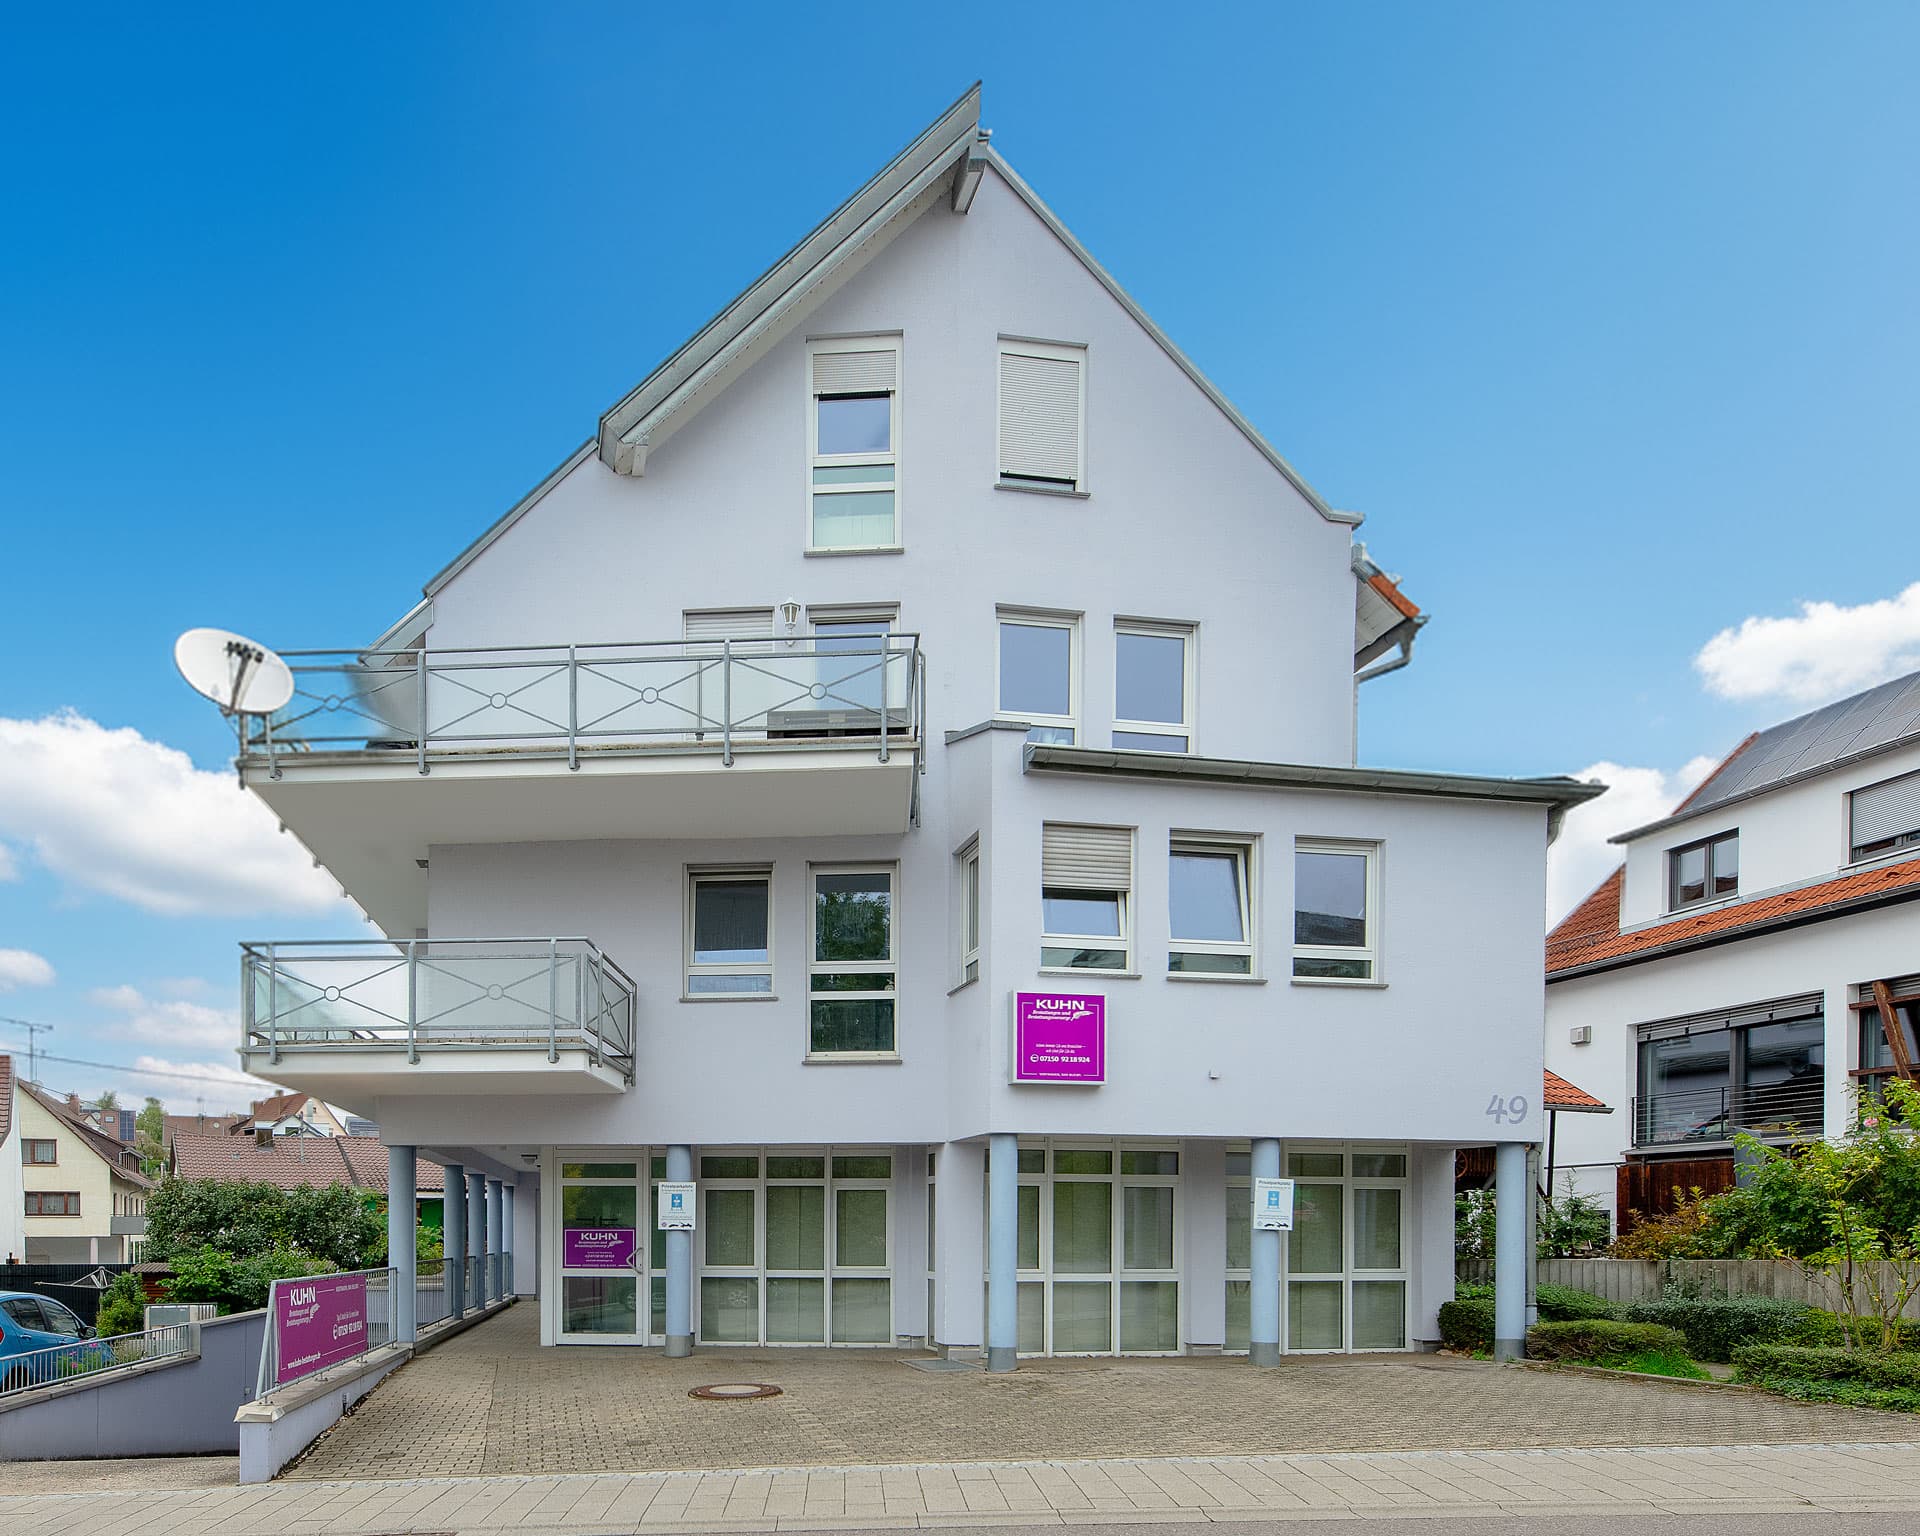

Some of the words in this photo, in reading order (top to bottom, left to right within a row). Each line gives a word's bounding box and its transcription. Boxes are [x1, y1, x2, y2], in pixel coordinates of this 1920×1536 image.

[1036, 999, 1085, 1010] KUHN
[1486, 1095, 1528, 1124] 49
[580, 1232, 618, 1240] KUHN
[290, 1286, 316, 1306] KUHN
